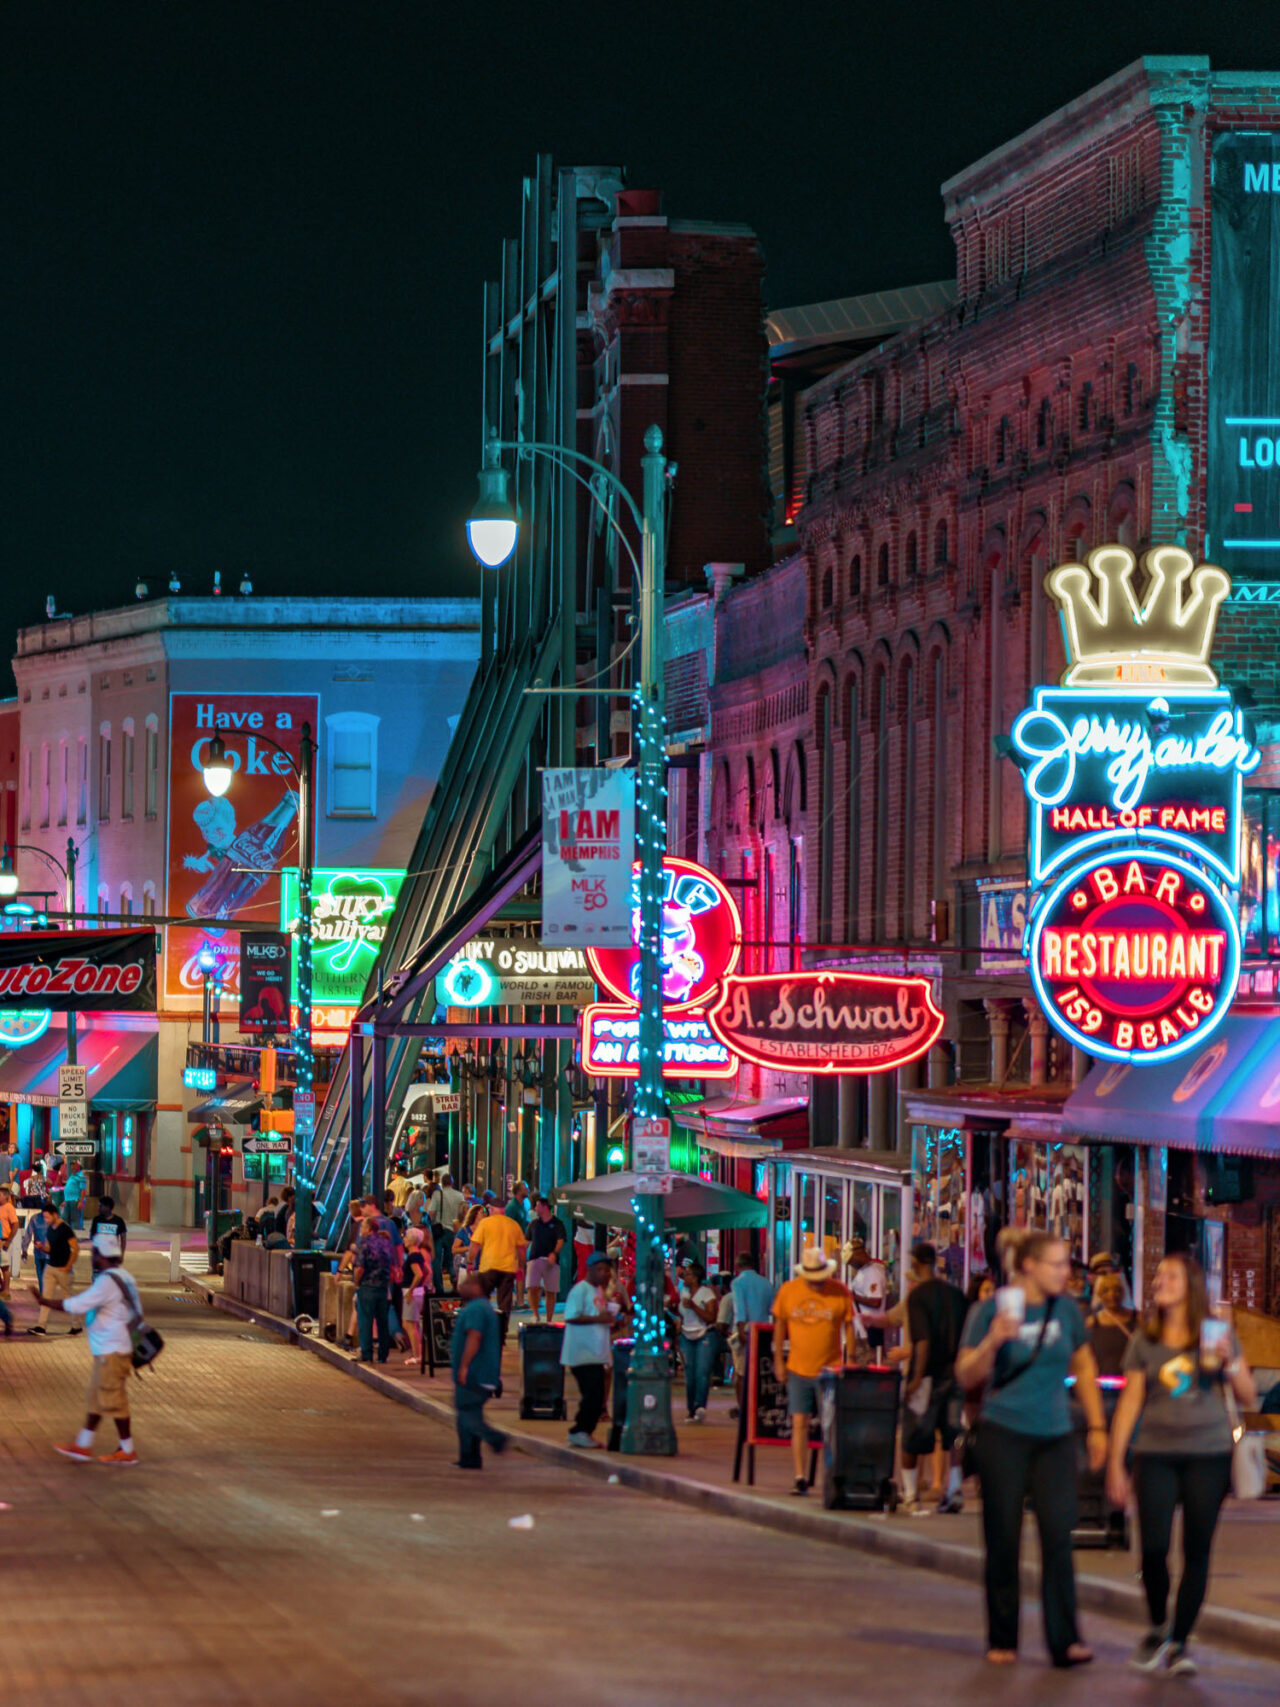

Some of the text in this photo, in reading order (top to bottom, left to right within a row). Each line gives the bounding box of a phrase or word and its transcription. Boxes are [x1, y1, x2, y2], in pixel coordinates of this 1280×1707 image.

[195, 703, 293, 730] Have a
[1013, 707, 1150, 806] Jerry
[559, 809, 620, 839] I AM
[1051, 806, 1226, 830] HALL OF FAME
[559, 845, 621, 860] MEMPHIS
[571, 878, 606, 893] MLK
[1092, 860, 1181, 907] BAR
[583, 892, 608, 911] 50
[212, 945, 240, 955] DRIN
[1044, 932, 1225, 980] RESTAURANT
[500, 981, 596, 990] WORLD FAMOU
[521, 991, 578, 1000] IRISH BAR
[721, 982, 930, 1031] A. Schwab
[1057, 987, 1214, 1049] 159 BEALE
[667, 1022, 713, 1039] WIT
[759, 1039, 896, 1058] ESTABLISHED 1876
[61, 1083, 84, 1097] 25
[435, 1095, 459, 1103] STREE
[441, 1102, 459, 1110] BAR
[255, 1141, 286, 1149] ONE WAY
